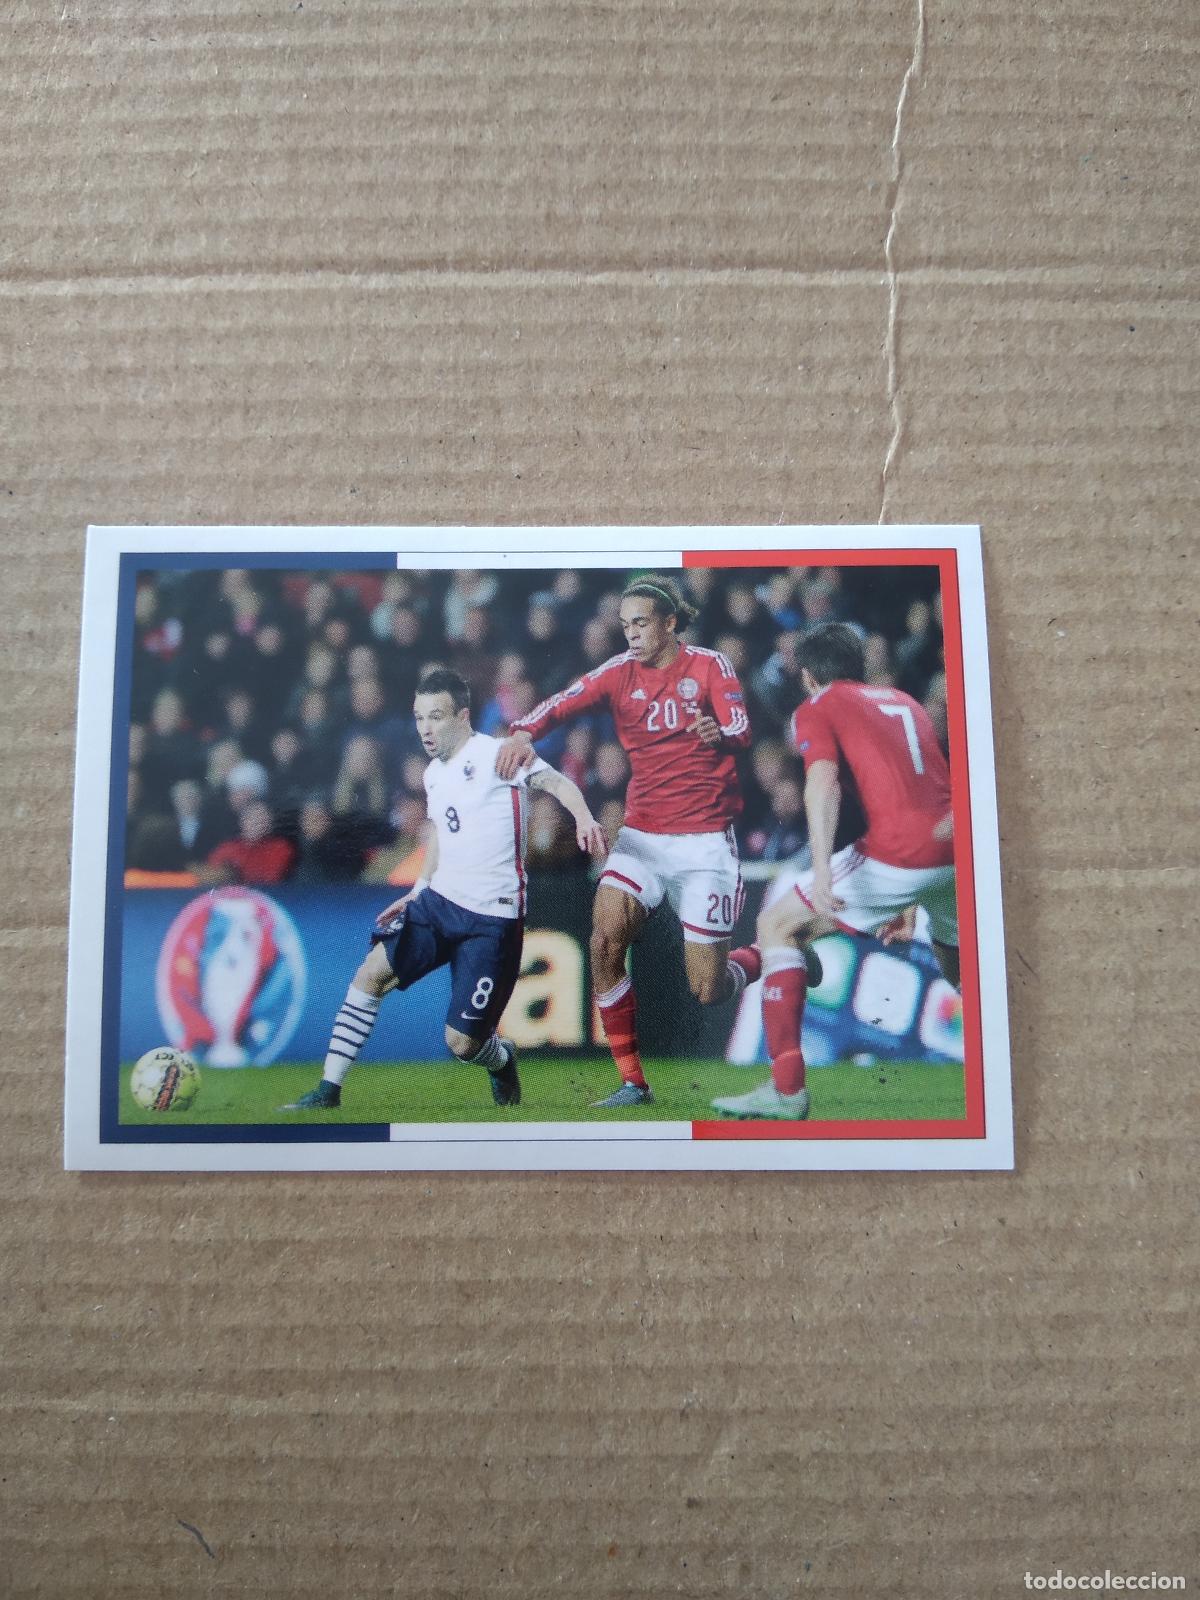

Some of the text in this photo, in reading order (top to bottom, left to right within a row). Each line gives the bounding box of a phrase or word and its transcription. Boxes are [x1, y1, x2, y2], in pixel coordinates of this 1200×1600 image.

[647, 698, 677, 731] 20
[878, 703, 925, 775] 7
[445, 805, 461, 833] 8
[706, 894, 731, 925] 20
[471, 976, 494, 1009] 8
[497, 928, 609, 1048] a
